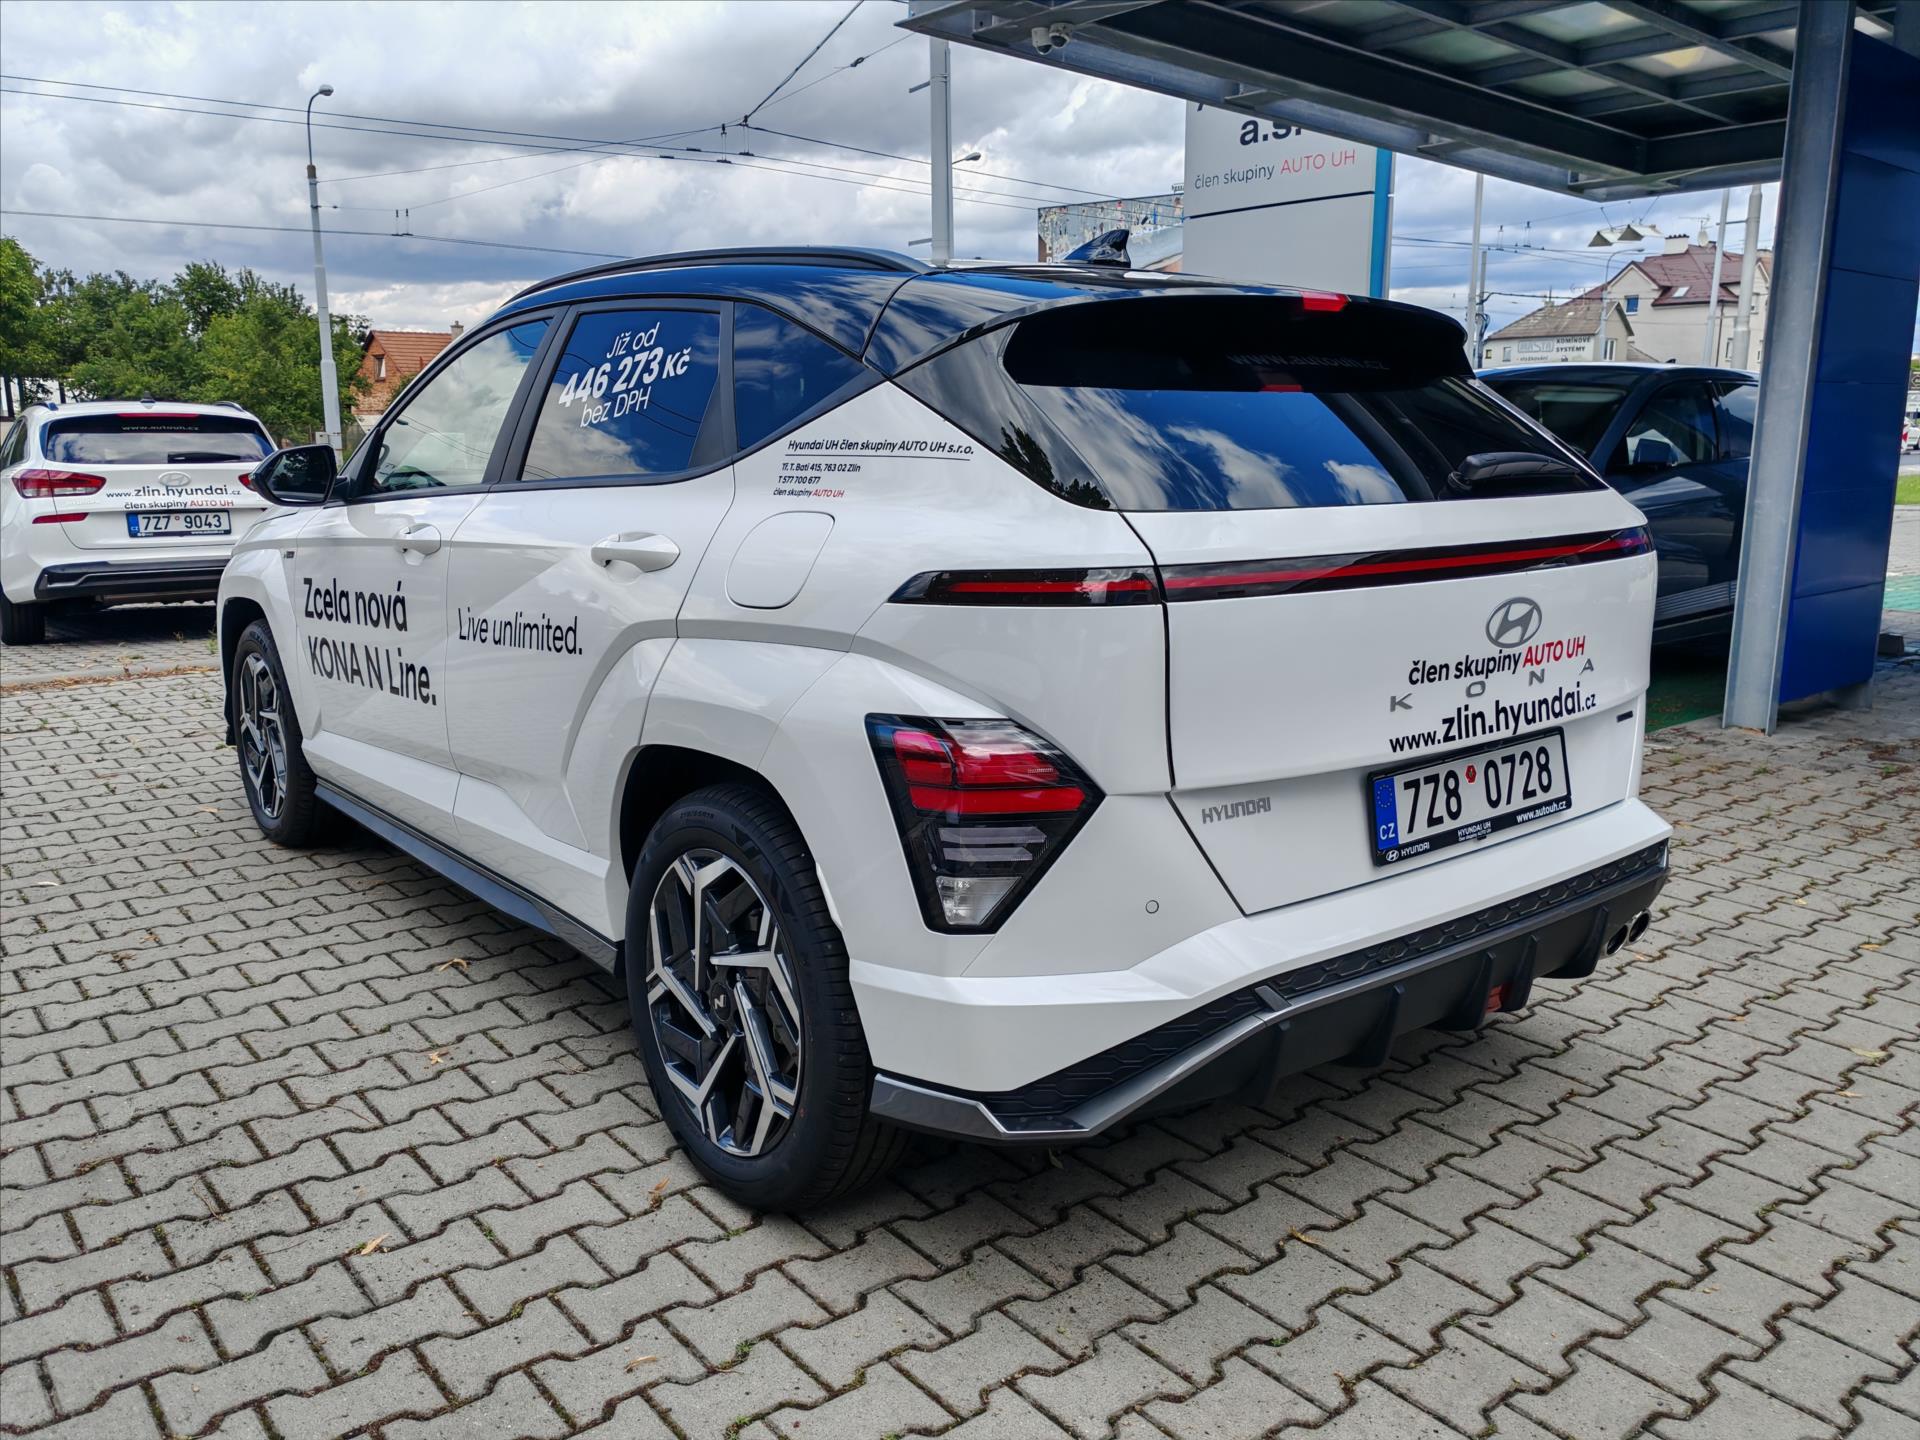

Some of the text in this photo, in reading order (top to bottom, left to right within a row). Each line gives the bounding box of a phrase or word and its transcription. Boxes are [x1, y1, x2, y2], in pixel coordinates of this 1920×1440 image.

[1194, 149, 1356, 190] člen skupiny AUTO UH
[606, 321, 661, 359] Již od
[558, 346, 692, 408] 446 273 Kč
[580, 385, 652, 428] bez DPH
[787, 439, 975, 455] Hyundai UH člen skupiny AUTO UH s.r.o.
[794, 476, 808, 484] 700
[823, 463, 837, 472] 763
[837, 463, 847, 472] 02
[106, 484, 242, 498] www.zlin.hyundai.cz
[124, 499, 234, 510] člen skupiny AUTO UH
[773, 487, 845, 498] člen skupiny AUTO UH
[141, 514, 222, 531] 7Z7 9043
[303, 577, 408, 632] Zcela nová
[458, 607, 583, 655] Live unlimited.
[308, 635, 365, 687] KONA
[364, 645, 384, 691] N
[385, 647, 437, 706] Line.
[1408, 635, 1586, 685] člen skupiny AUTO UH
[1389, 681, 1596, 753] www.zlin.hyundai.cz
[1403, 745, 1553, 834] 7Z8 0728
[1201, 796, 1271, 825] HYUNDAI
[1516, 800, 1567, 823] www.autouh.cz
[1379, 822, 1396, 840] CZ
[1401, 841, 1430, 857] HYUNDAI
